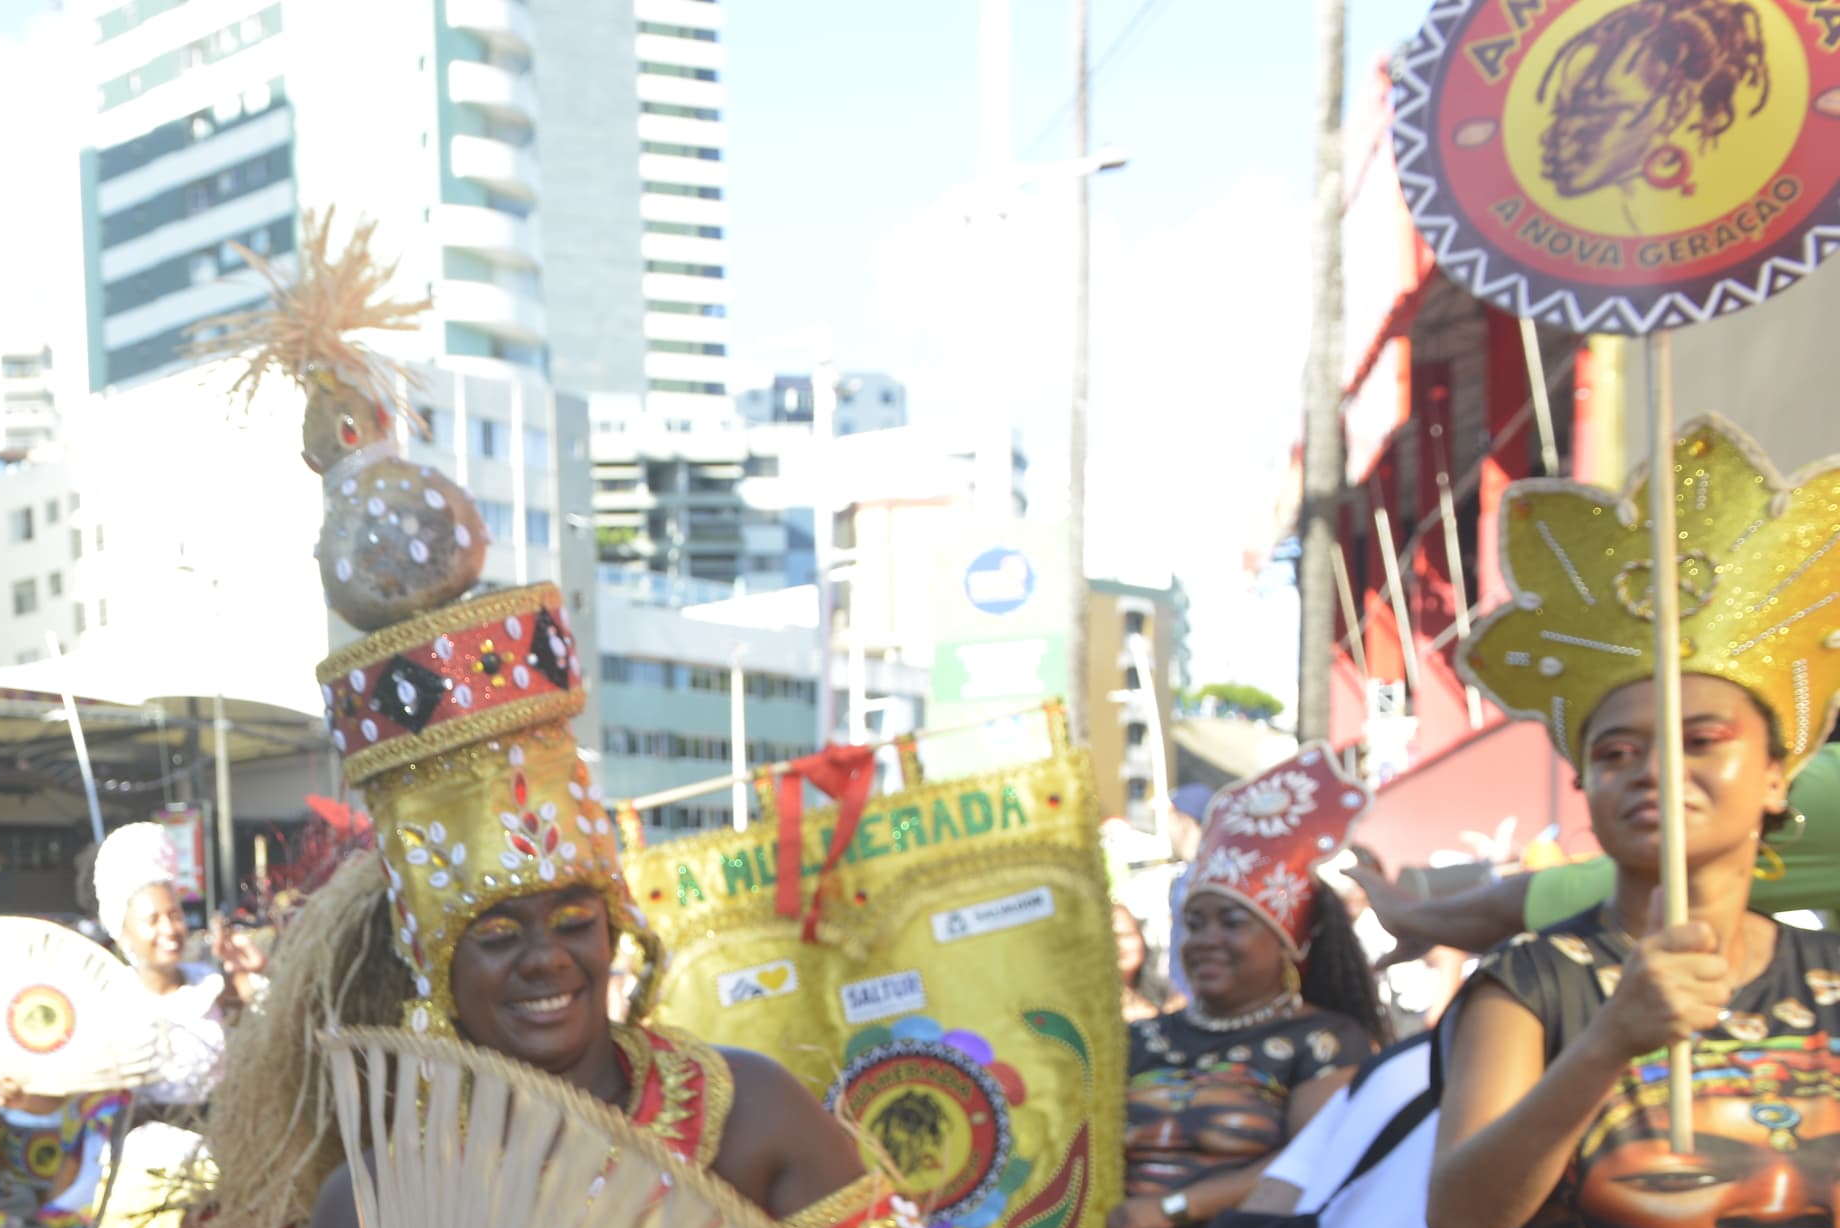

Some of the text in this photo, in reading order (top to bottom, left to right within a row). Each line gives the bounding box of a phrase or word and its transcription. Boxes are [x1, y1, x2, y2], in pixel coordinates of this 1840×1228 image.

[1494, 196, 1523, 223] A
[1520, 215, 1624, 266] NOVA
[677, 784, 1029, 907] A MUHERADA
